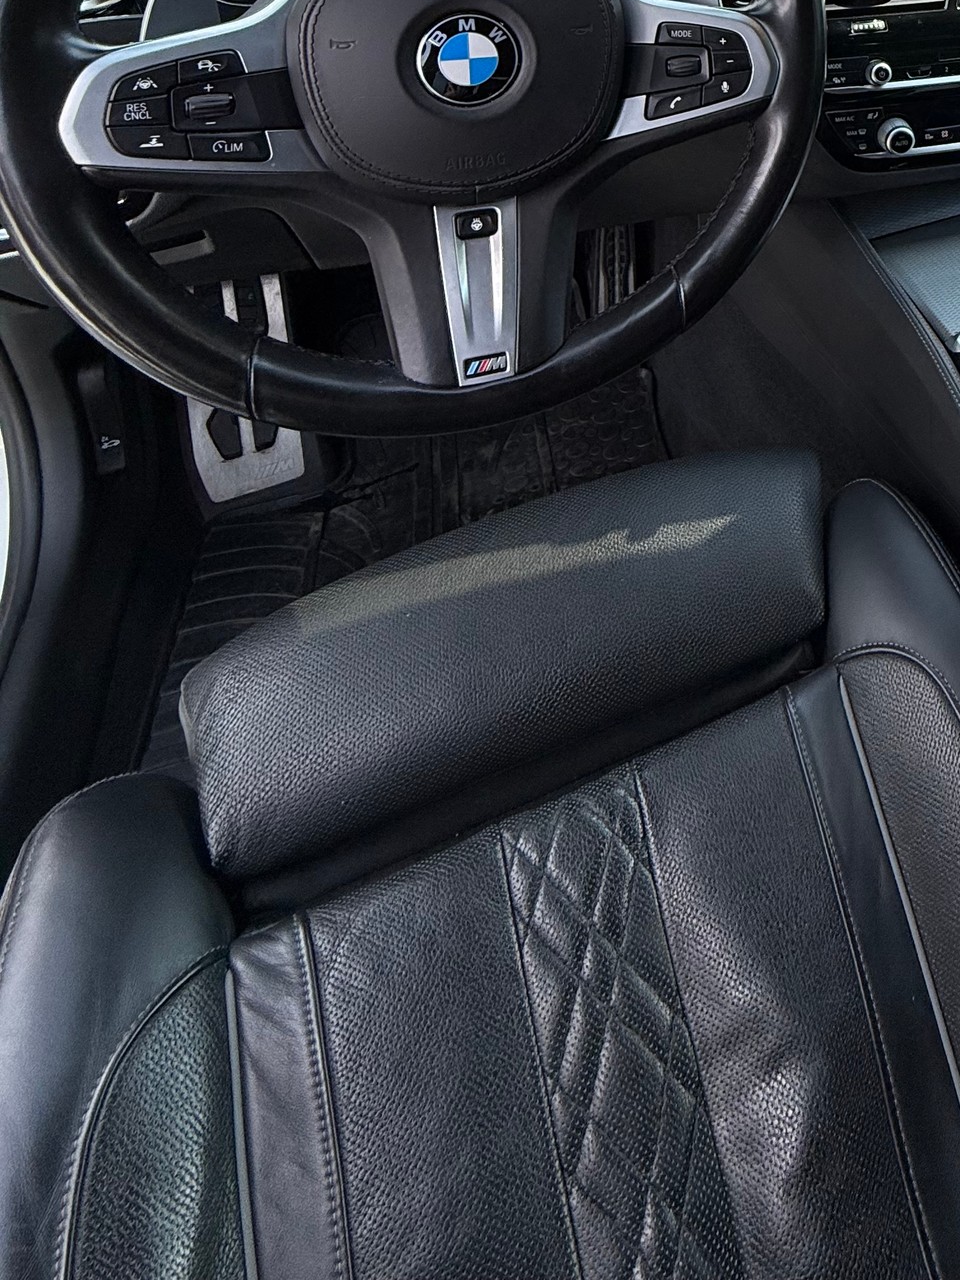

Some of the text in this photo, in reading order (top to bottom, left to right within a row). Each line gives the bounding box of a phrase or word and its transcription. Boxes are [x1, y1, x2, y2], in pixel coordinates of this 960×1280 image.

[428, 18, 507, 47] BMW
[671, 30, 692, 38] MODE
[126, 103, 147, 112] RES
[123, 110, 152, 121] CNCL
[224, 142, 243, 153] LIM
[446, 152, 506, 171] AIRBAG
